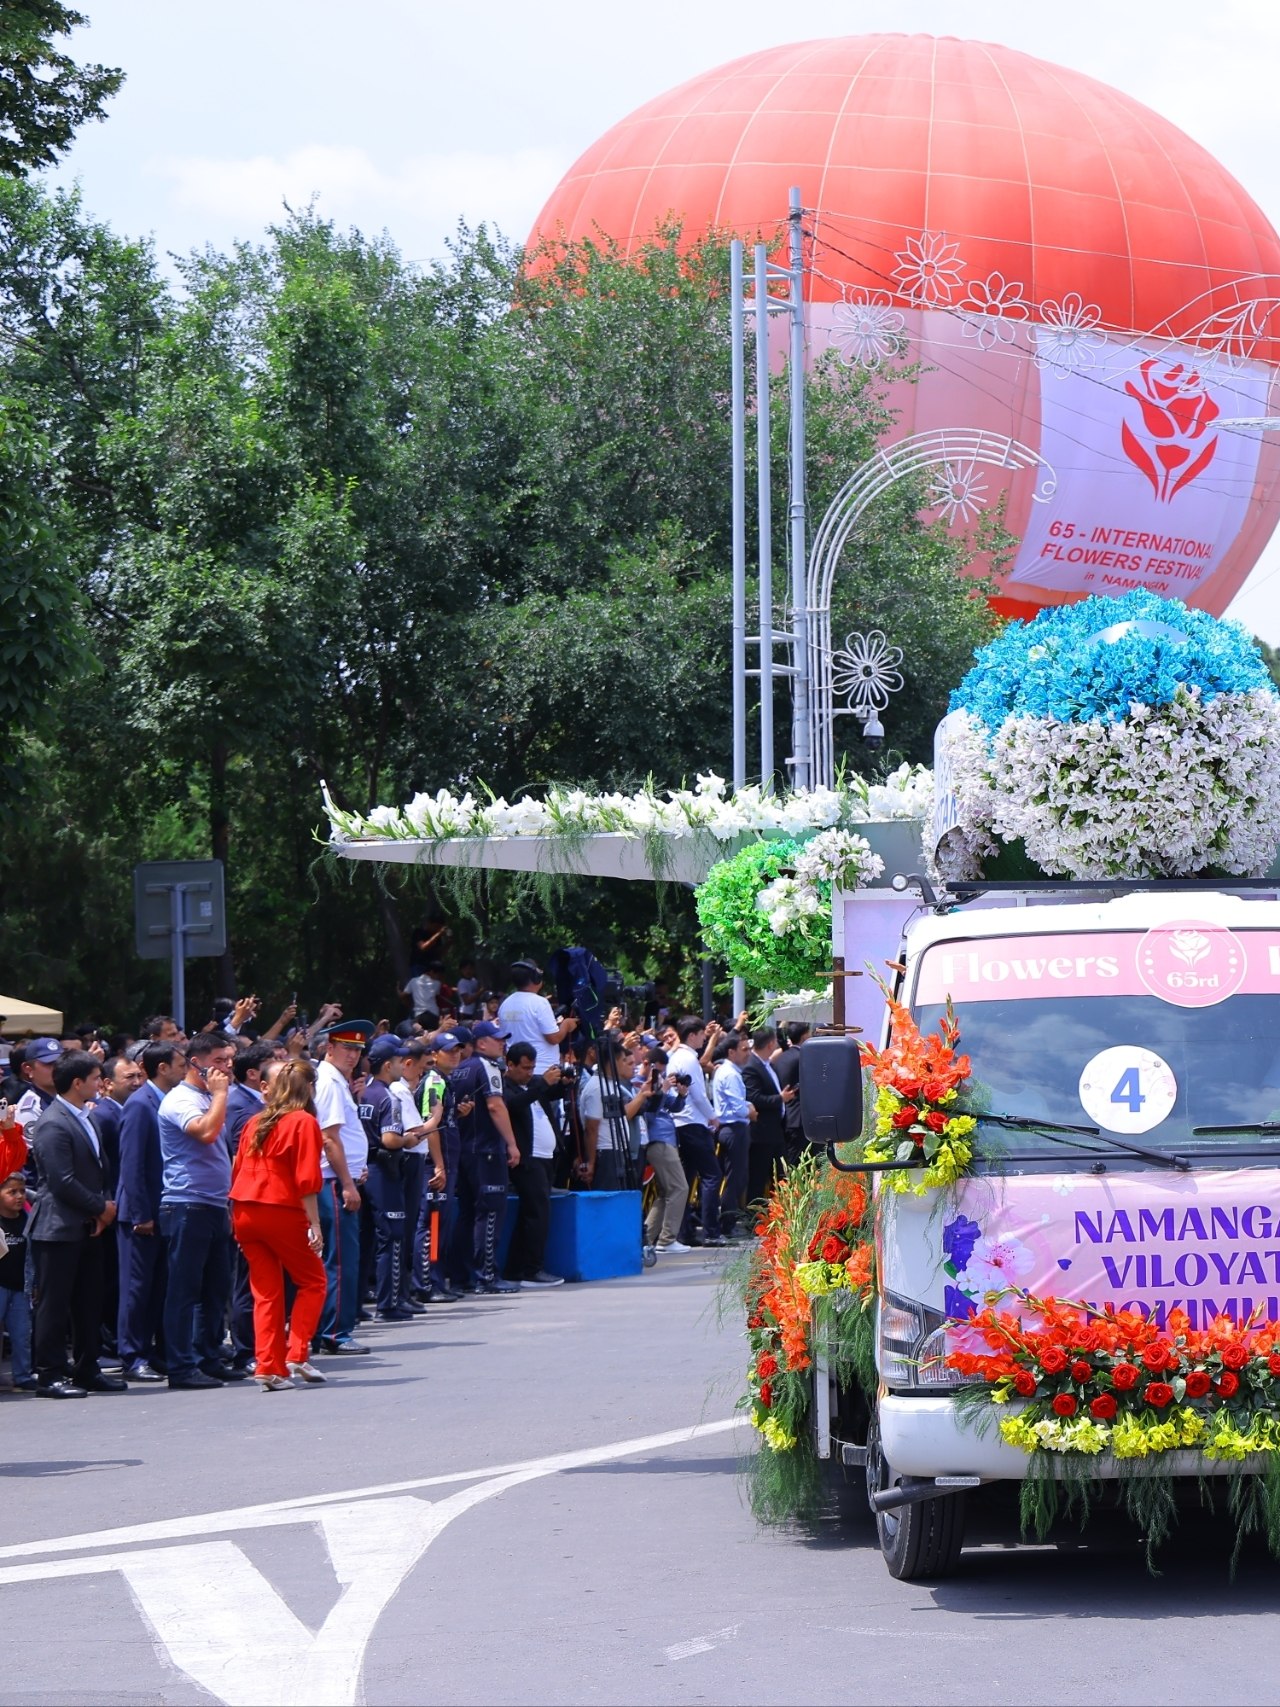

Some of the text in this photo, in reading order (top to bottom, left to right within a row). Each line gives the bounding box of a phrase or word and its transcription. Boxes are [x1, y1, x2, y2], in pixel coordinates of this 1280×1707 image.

[1049, 521, 1076, 539] 65
[1040, 543, 1142, 572] FLOWERS
[1084, 571, 1095, 580] in
[941, 952, 1120, 985] Flowers
[1110, 1067, 1146, 1112] 4
